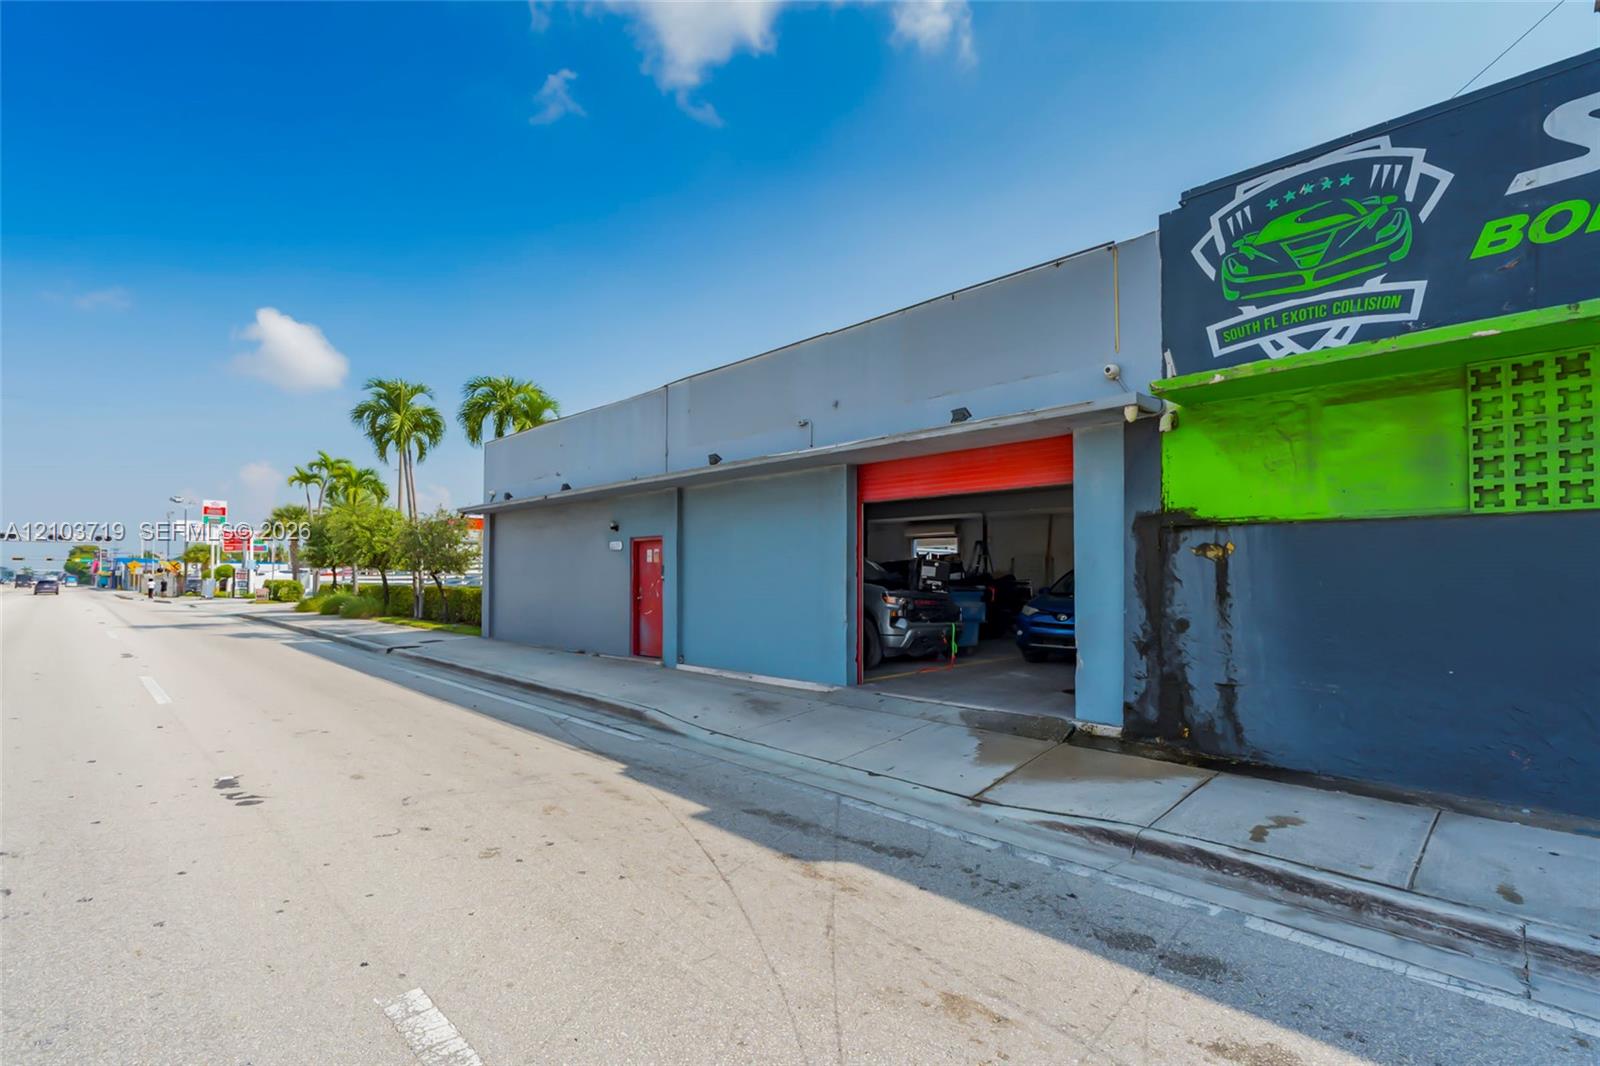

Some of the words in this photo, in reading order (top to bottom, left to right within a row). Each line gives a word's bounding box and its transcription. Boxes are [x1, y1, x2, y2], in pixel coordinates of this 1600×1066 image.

[1469, 199, 1600, 260] BO
[1222, 320, 1260, 343] SOUTH
[1264, 317, 1278, 331] FL
[1282, 305, 1328, 326] EXOTIC
[1332, 295, 1402, 316] COLLISION
